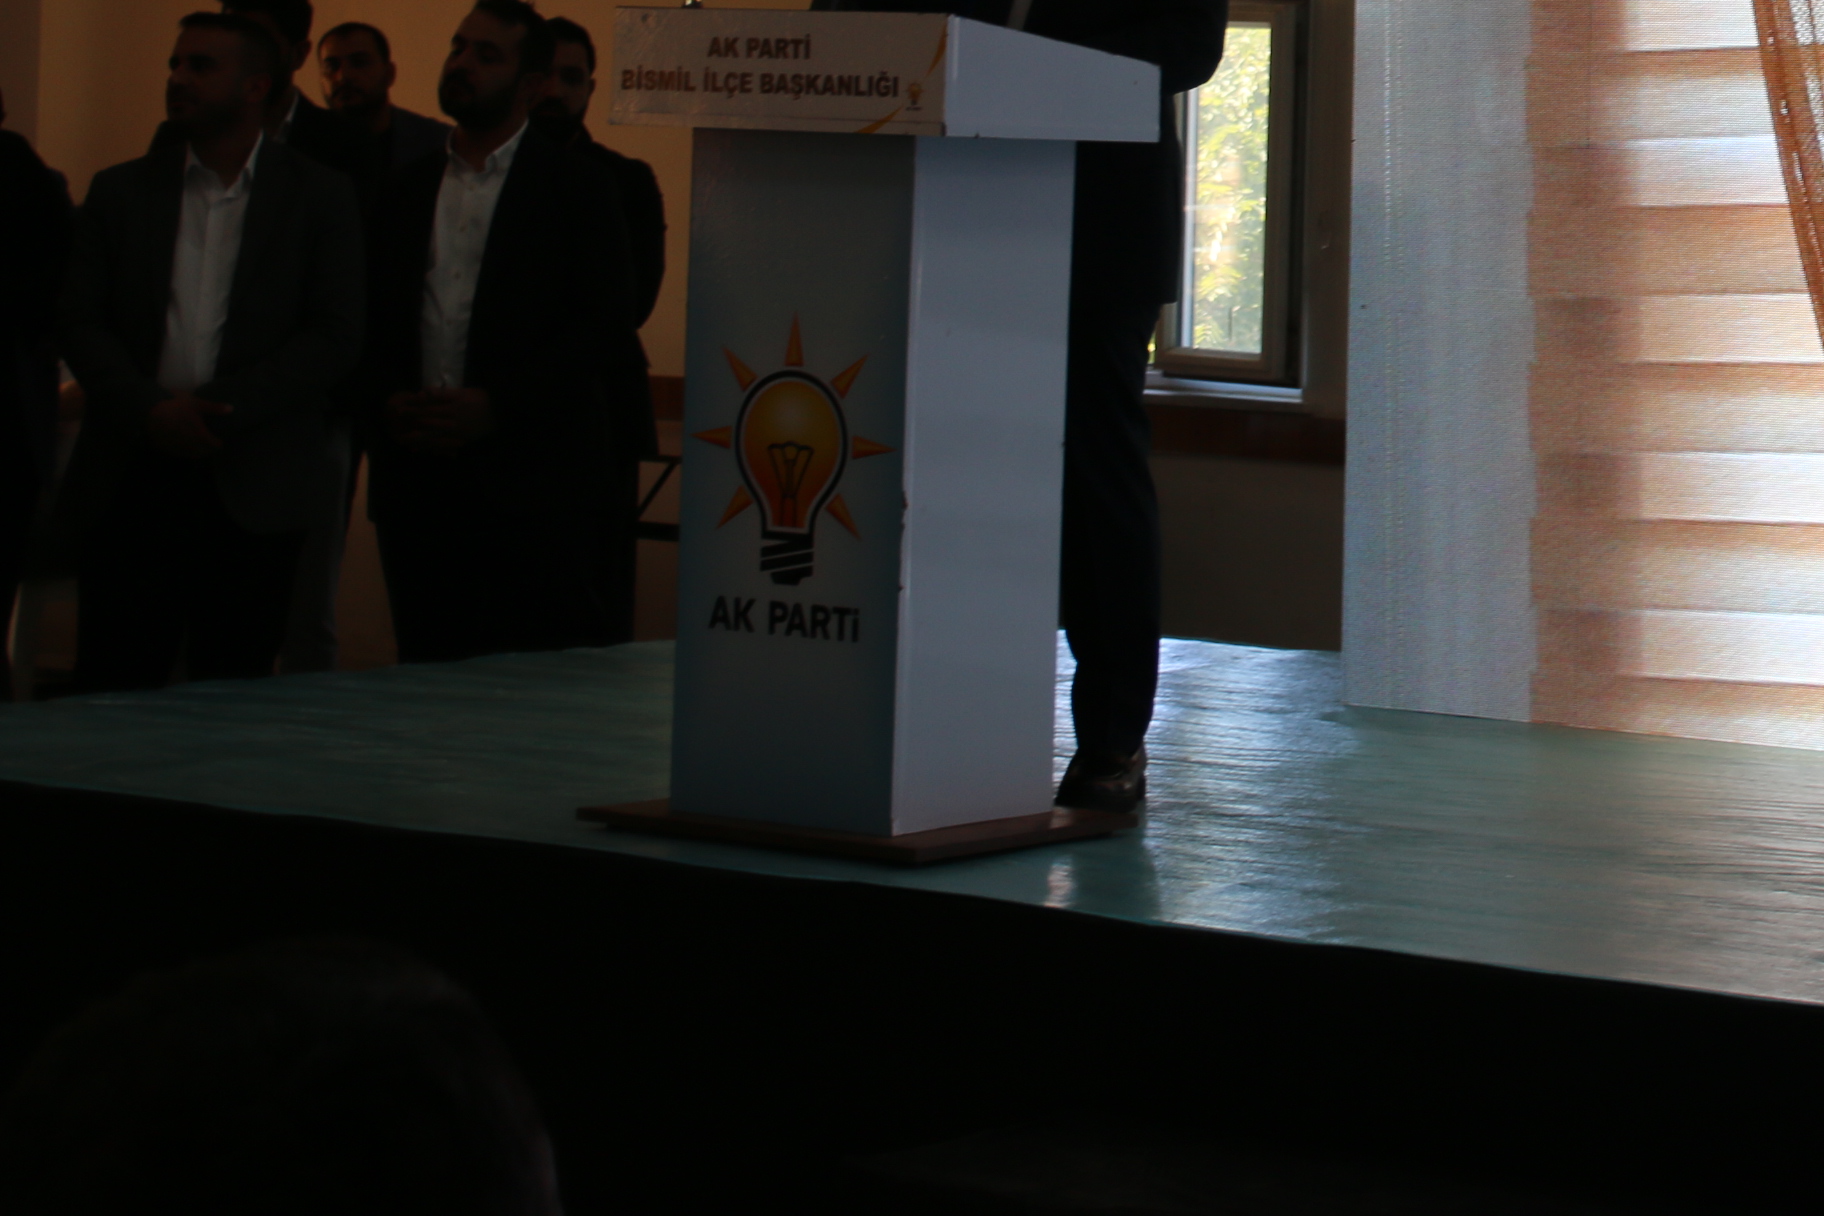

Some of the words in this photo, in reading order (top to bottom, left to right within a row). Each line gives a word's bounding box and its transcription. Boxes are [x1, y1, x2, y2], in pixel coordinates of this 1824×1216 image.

[707, 36, 740, 58] AK
[745, 33, 812, 60] PARTİ
[621, 64, 697, 92] BİSMİL
[703, 66, 754, 99] İLÇE
[759, 70, 899, 101] BAŞKANLIĞI
[707, 595, 757, 633] AK
